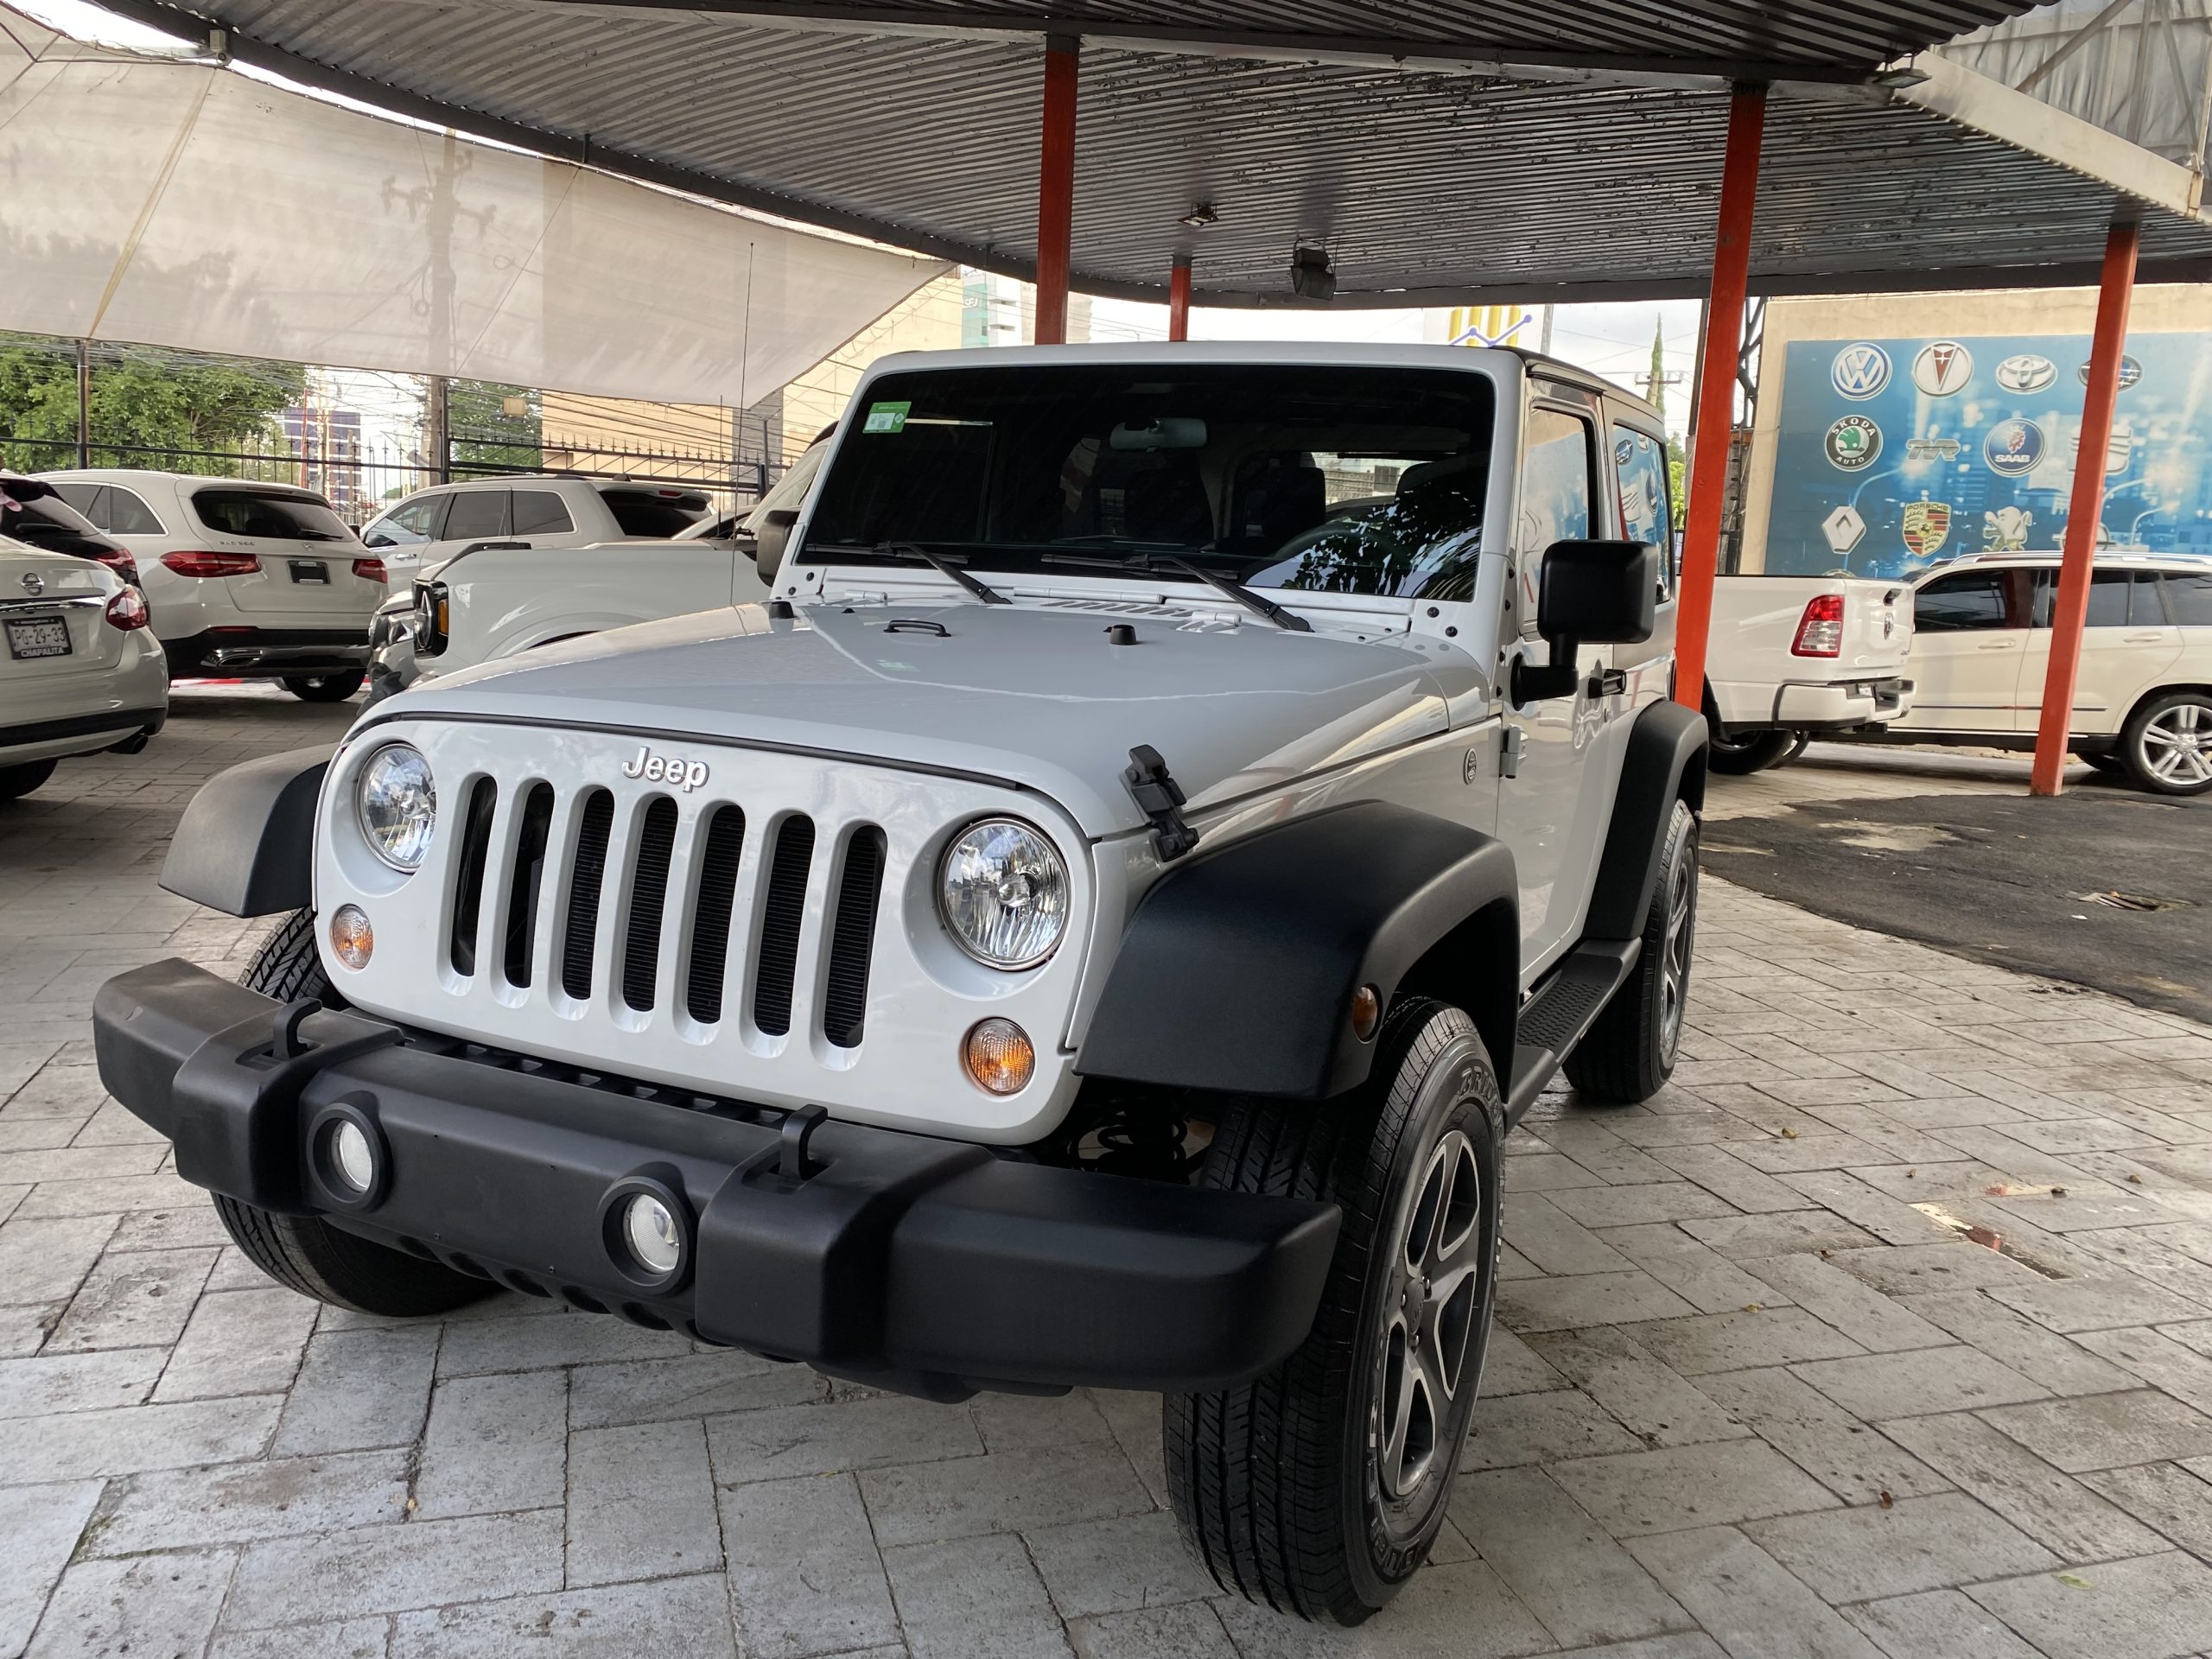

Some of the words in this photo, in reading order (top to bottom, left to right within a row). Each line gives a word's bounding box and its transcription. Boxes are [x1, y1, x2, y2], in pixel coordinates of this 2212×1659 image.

[1832, 417, 1876, 436] SKODA
[1835, 456, 1865, 466] AUTO
[1994, 454, 2031, 463] SAAB
[1906, 503, 1949, 512] PORSCHE
[21, 646, 65, 657] CHAPALITA
[621, 746, 710, 793] Jeep
